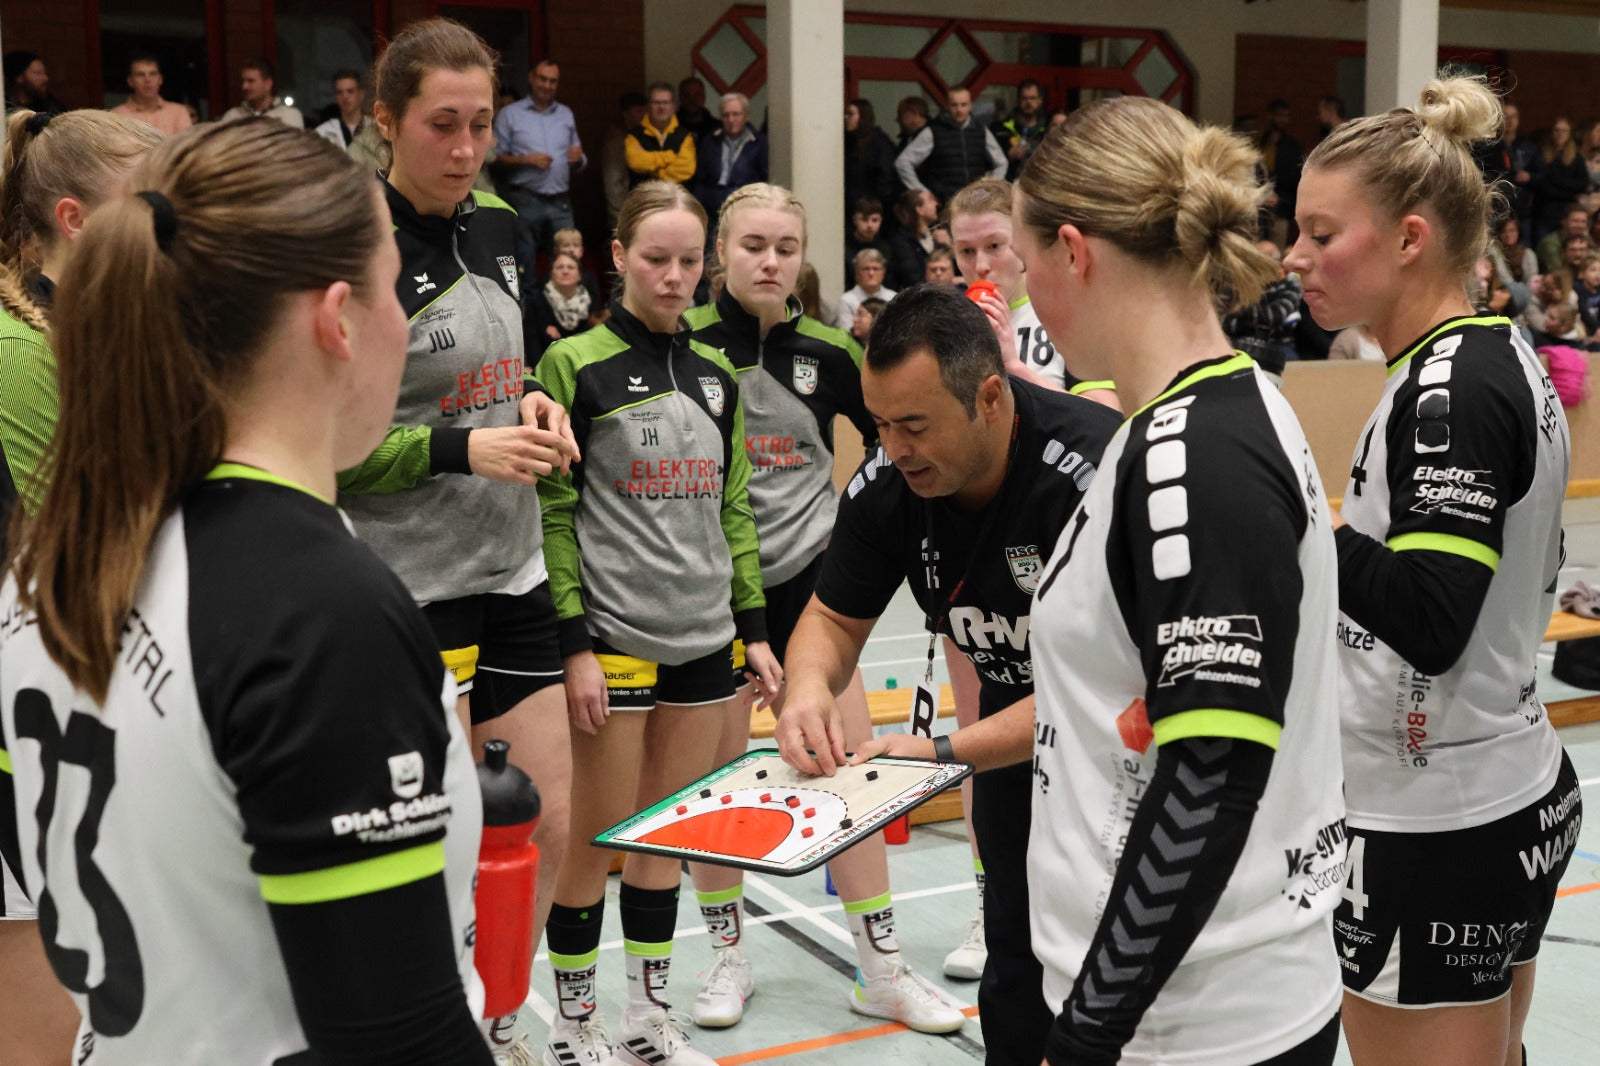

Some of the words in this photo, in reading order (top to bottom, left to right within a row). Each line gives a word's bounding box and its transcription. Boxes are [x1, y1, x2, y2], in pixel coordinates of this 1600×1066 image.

[428, 327, 456, 354] JW
[1017, 325, 1055, 367] 18
[640, 427, 660, 447] JH
[331, 808, 390, 836] Dirk
[1341, 834, 1369, 922] 4
